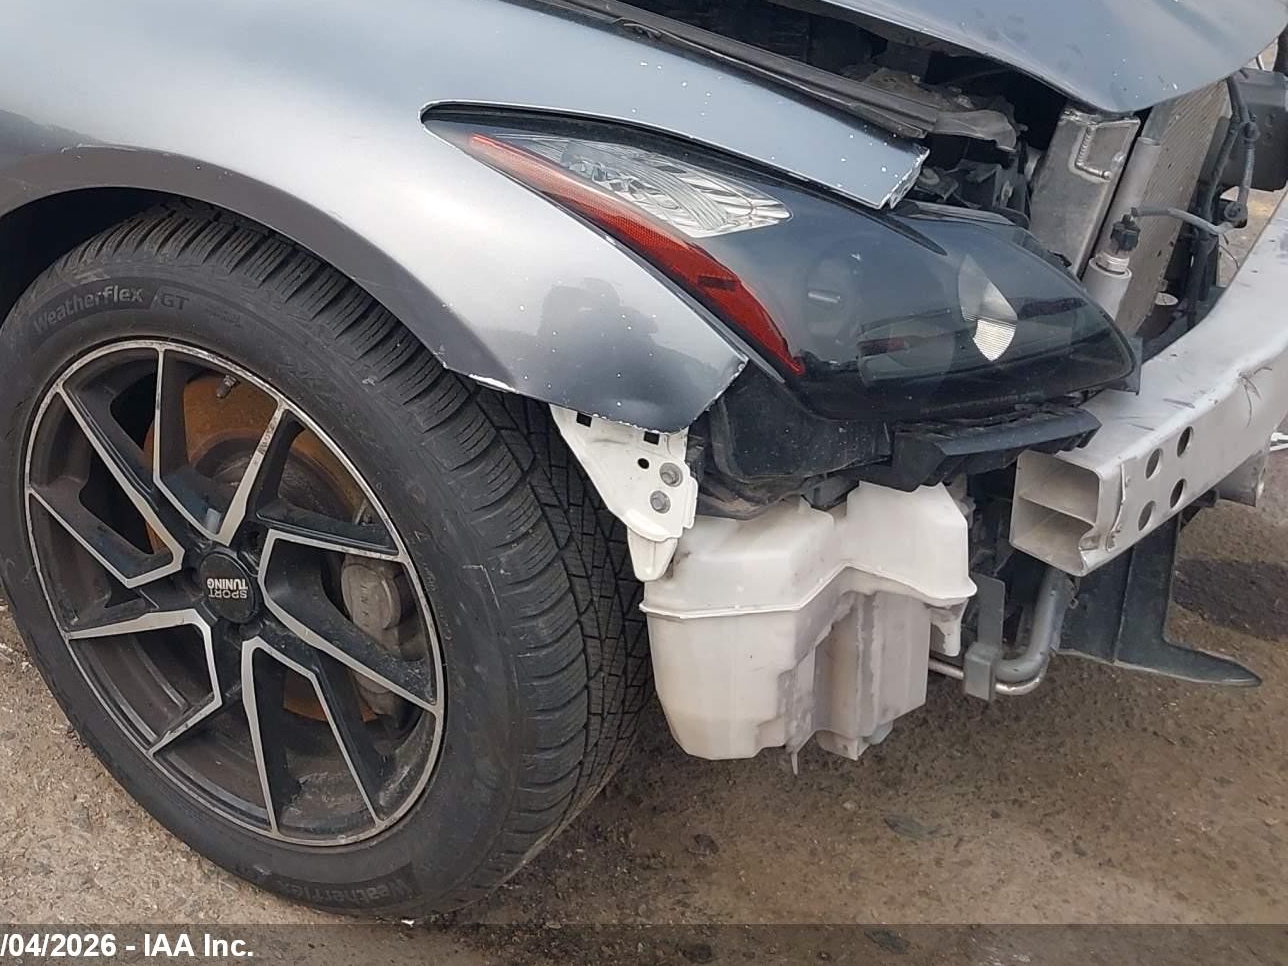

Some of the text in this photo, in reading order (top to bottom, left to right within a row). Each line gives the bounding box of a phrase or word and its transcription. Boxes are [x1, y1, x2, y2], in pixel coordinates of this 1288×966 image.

[33, 285, 144, 333] Weatherflex
[206, 577, 249, 590] TUNING
[208, 589, 248, 599] SPORT
